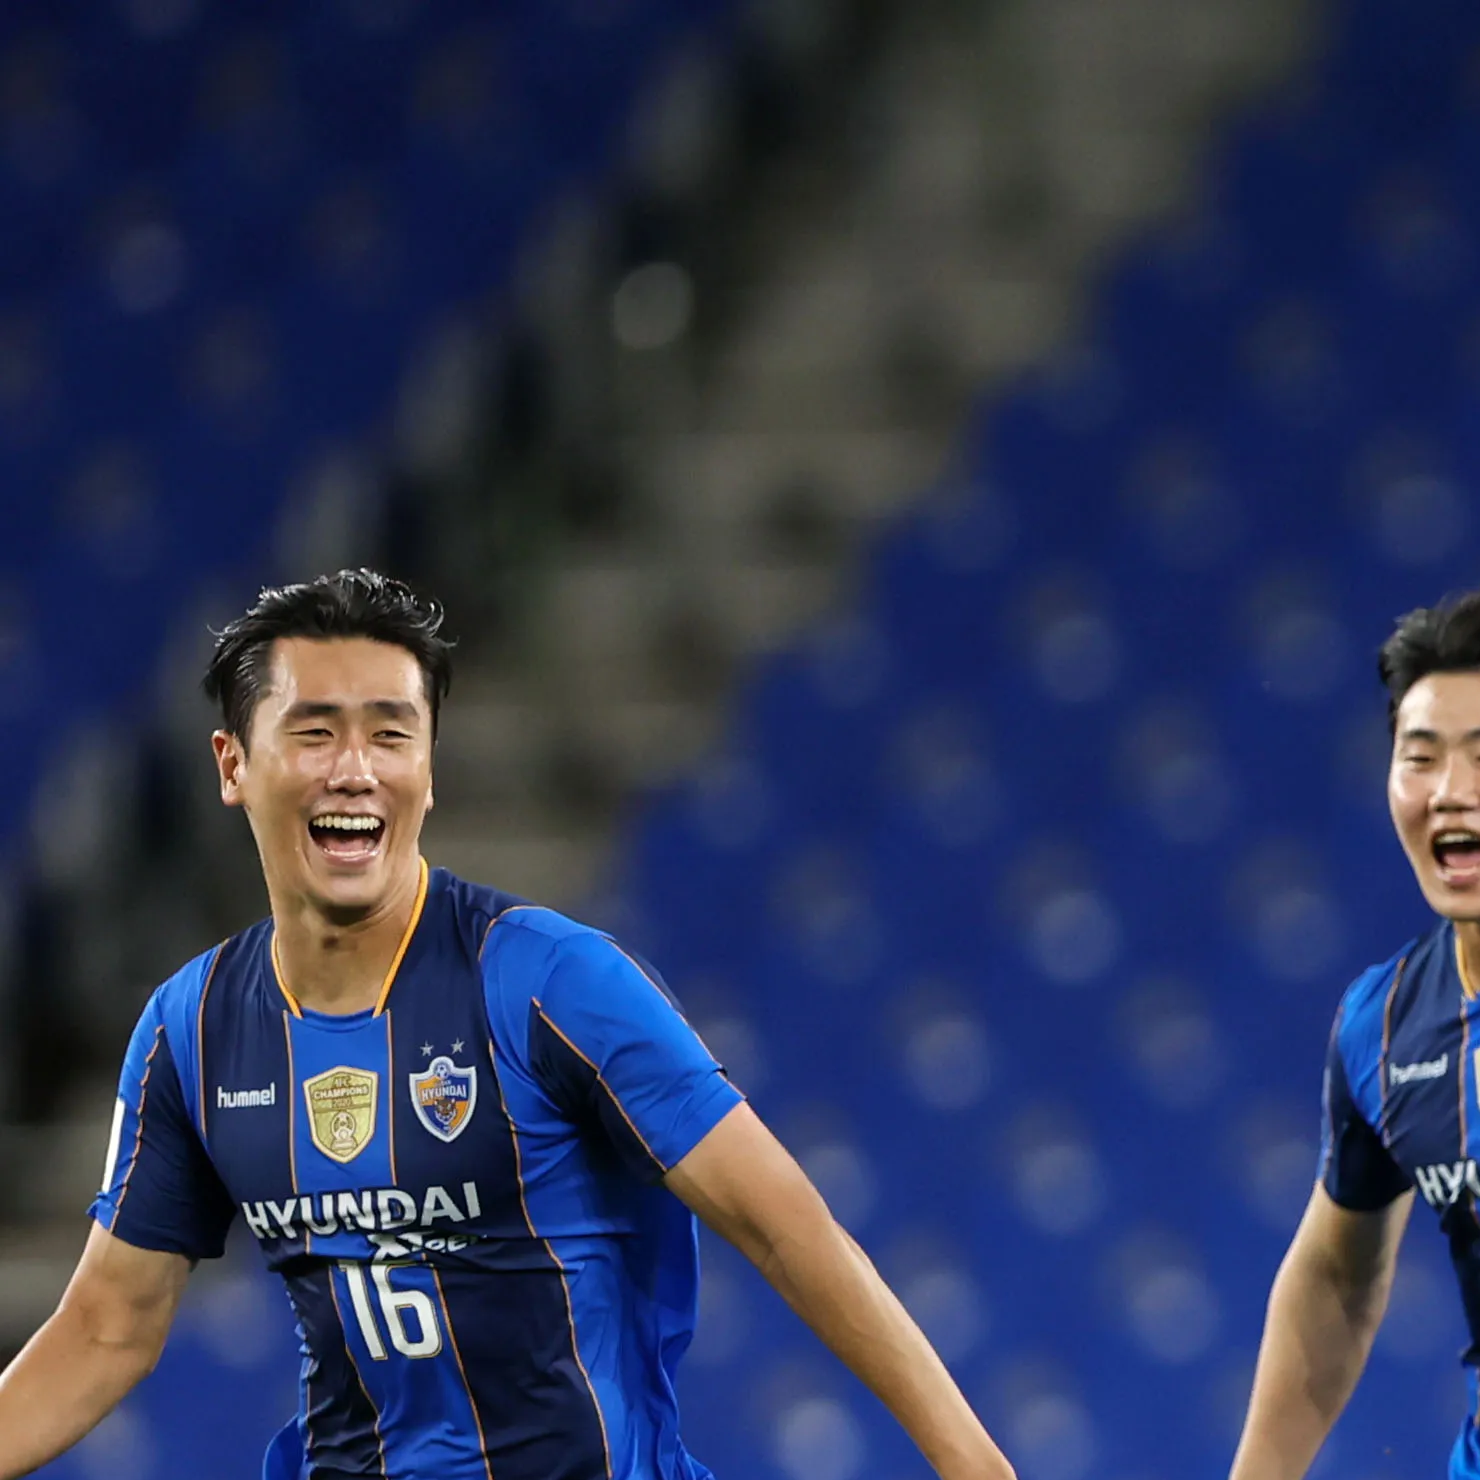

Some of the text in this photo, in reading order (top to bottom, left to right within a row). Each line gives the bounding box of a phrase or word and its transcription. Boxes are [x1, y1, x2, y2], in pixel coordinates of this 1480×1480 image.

[217, 1082, 275, 1108] hummel
[313, 1086, 369, 1099] CHAMPIONS
[421, 1085, 467, 1099] HYUNDAI
[242, 1181, 482, 1239] HYUNDAI
[337, 1260, 443, 1361] 16
